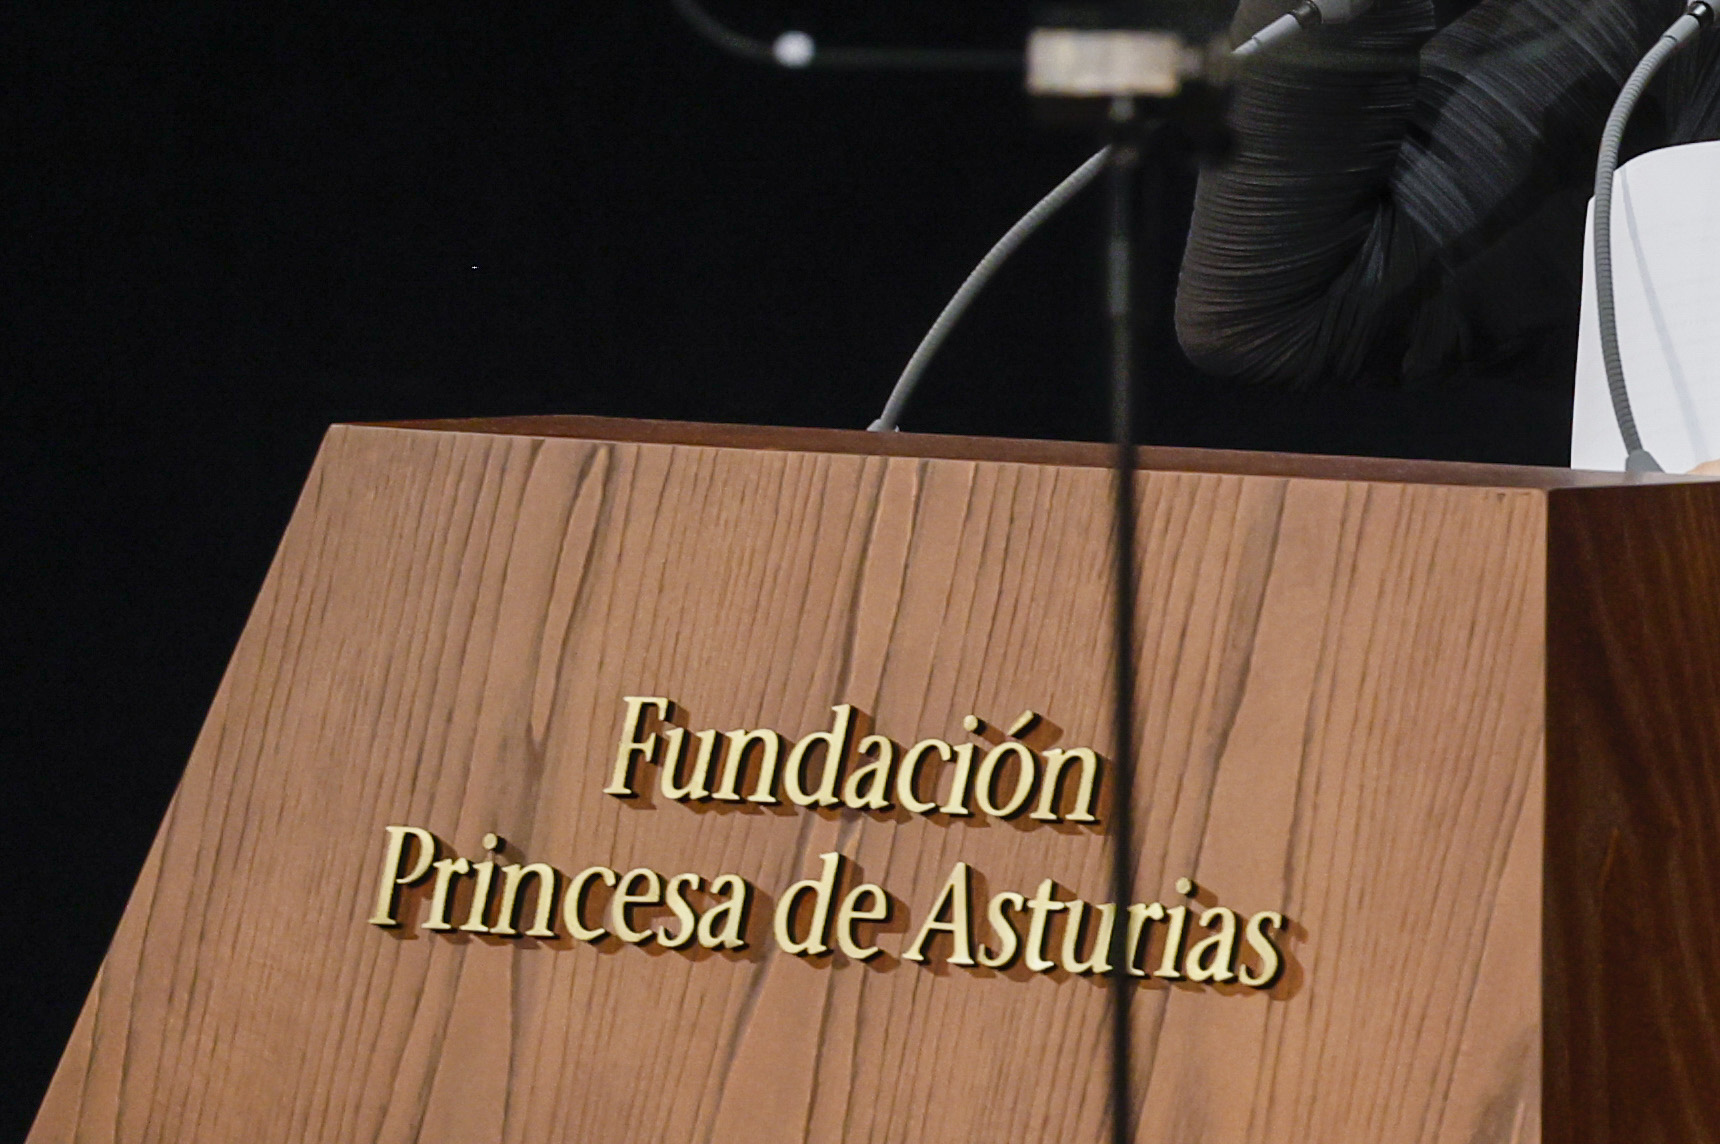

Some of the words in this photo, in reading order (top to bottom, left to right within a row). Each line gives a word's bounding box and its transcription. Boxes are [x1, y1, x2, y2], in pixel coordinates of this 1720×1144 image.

[602, 695, 1099, 822] Fundación
[368, 824, 747, 950] Princesa
[774, 851, 888, 960] de
[902, 861, 1284, 987] Asturias
